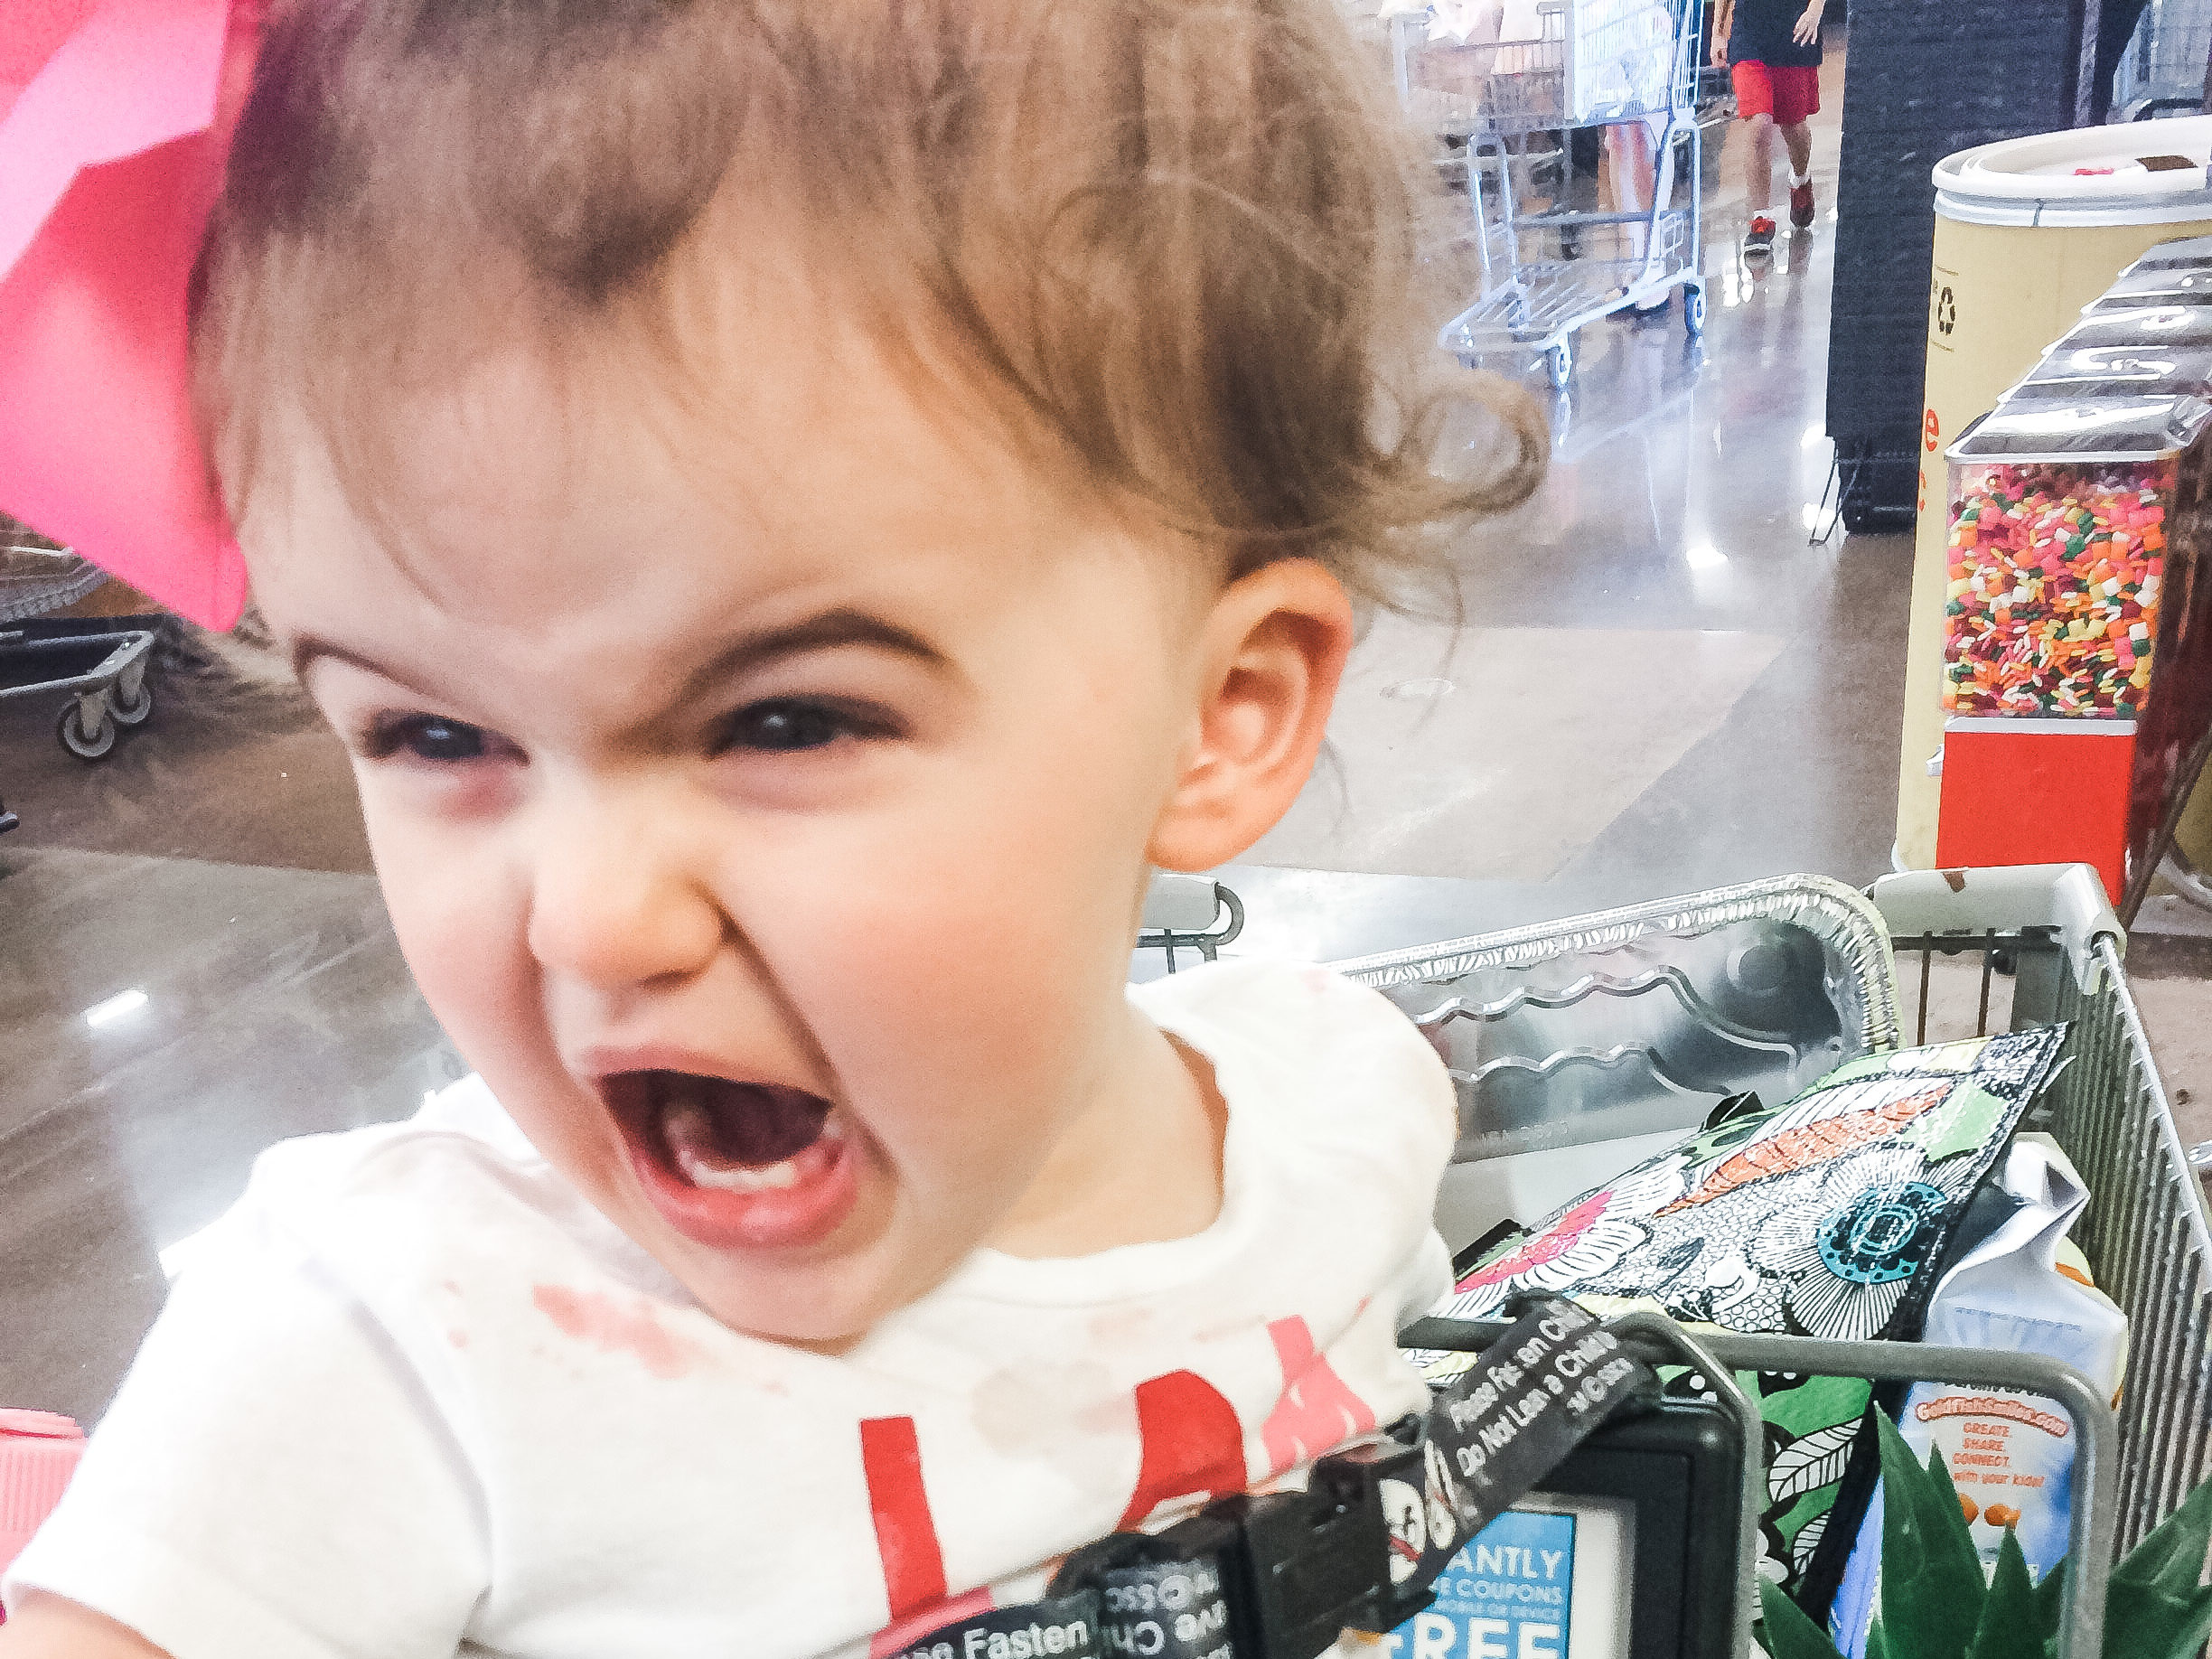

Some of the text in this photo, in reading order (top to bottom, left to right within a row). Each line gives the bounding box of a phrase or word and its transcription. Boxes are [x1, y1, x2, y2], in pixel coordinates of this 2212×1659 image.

[1457, 1444, 1486, 1477] Do
[1478, 1414, 1518, 1456] Not
[1456, 1577, 1563, 1605] COUPONS
[962, 1620, 1089, 1659] Fasten
